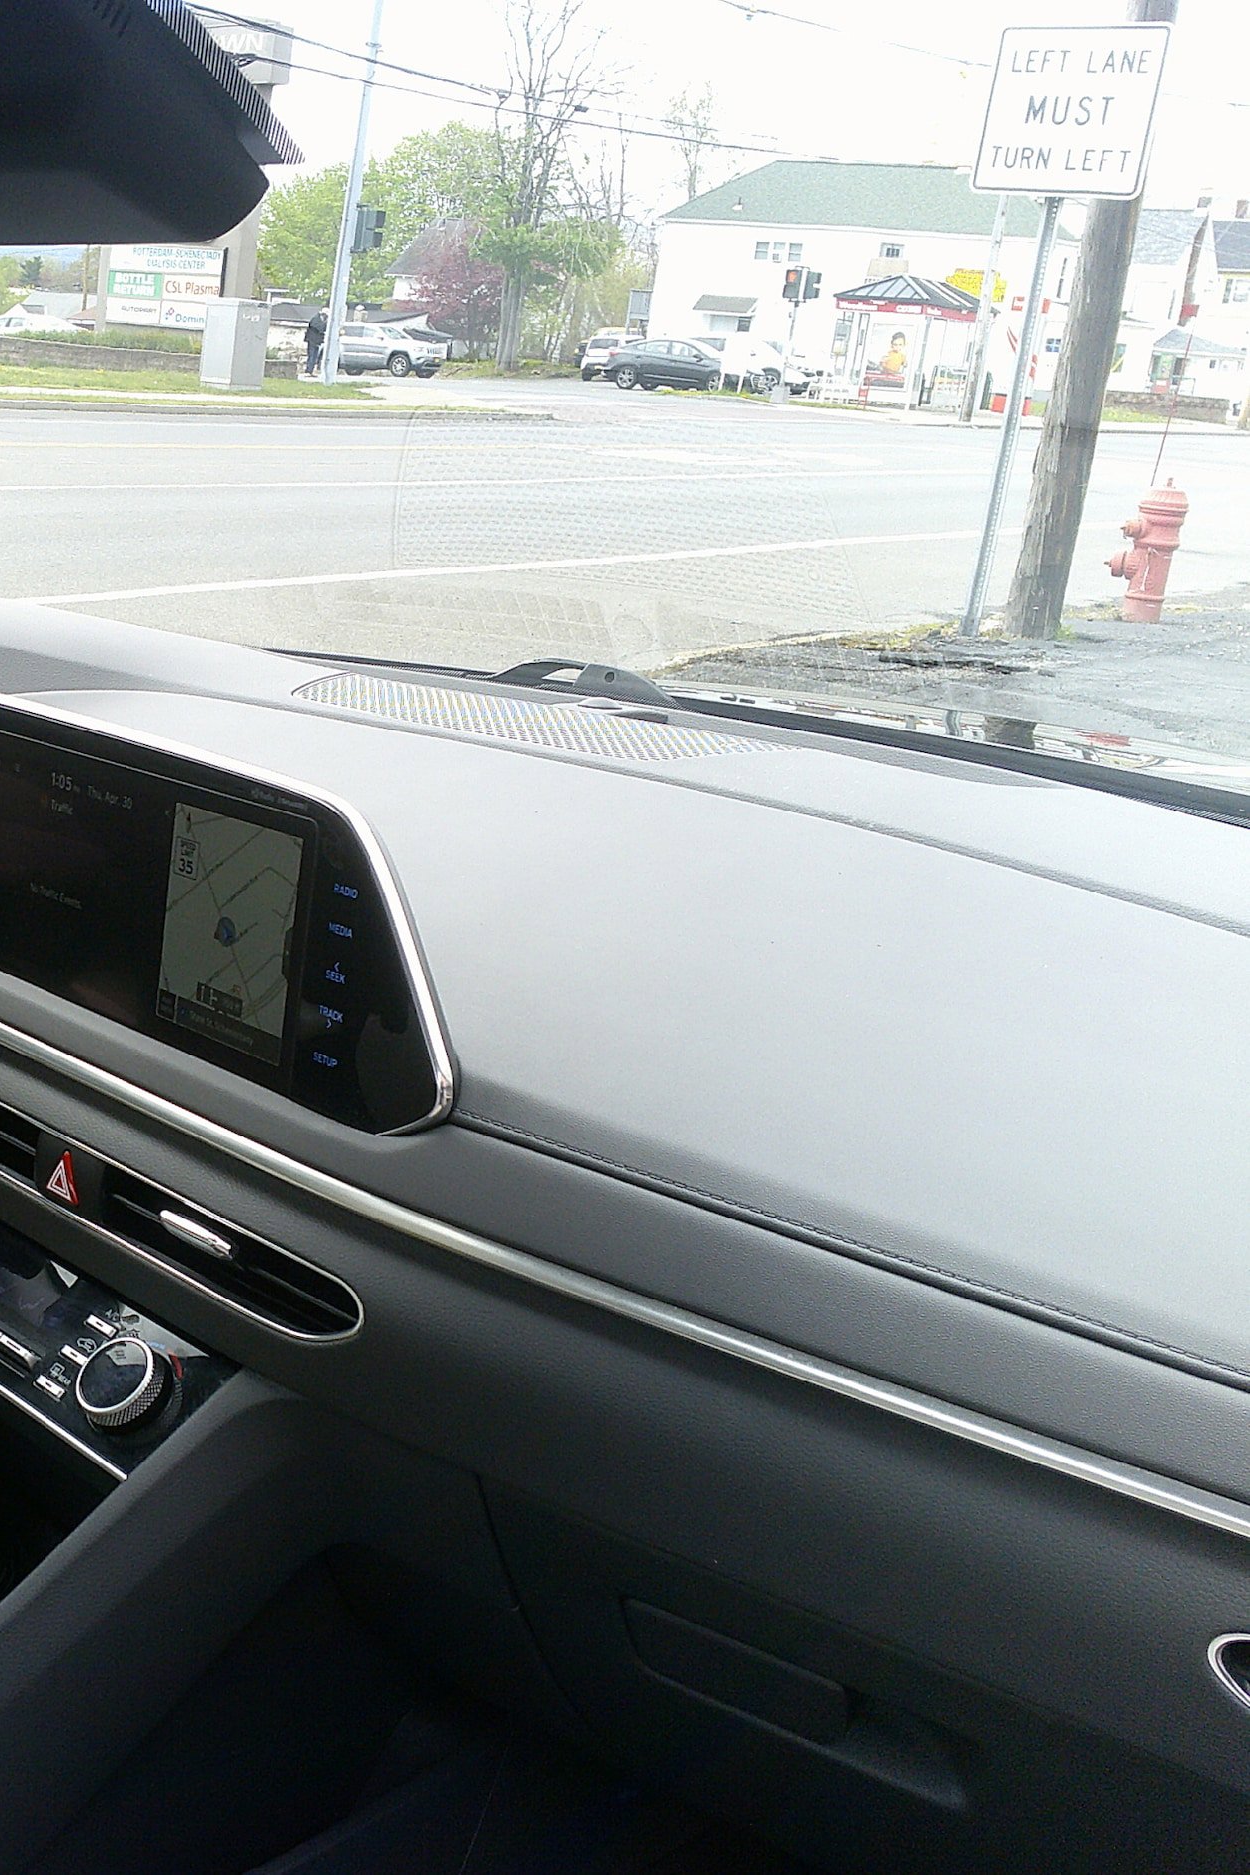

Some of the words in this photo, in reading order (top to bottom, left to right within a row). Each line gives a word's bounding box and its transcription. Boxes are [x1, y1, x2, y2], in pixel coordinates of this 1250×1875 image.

[1011, 49, 1071, 74] LEFT
[1086, 49, 1152, 74] LANE
[1024, 94, 1115, 126] MUST
[991, 145, 1052, 170] TURN
[1064, 149, 1132, 173] LEFT
[178, 259, 206, 270] CENTER
[114, 271, 155, 285] BOTTLE
[165, 280, 183, 294] CSL
[185, 281, 220, 296] Plasma
[51, 772, 73, 792] 1:05
[51, 798, 74, 816] Traffic
[178, 857, 193, 875] 35
[334, 883, 358, 899] RADIO
[328, 921, 354, 939] MEDIA
[325, 969, 346, 985] SEEK
[319, 1004, 344, 1023] TRACK
[312, 1051, 339, 1068] SETUP
